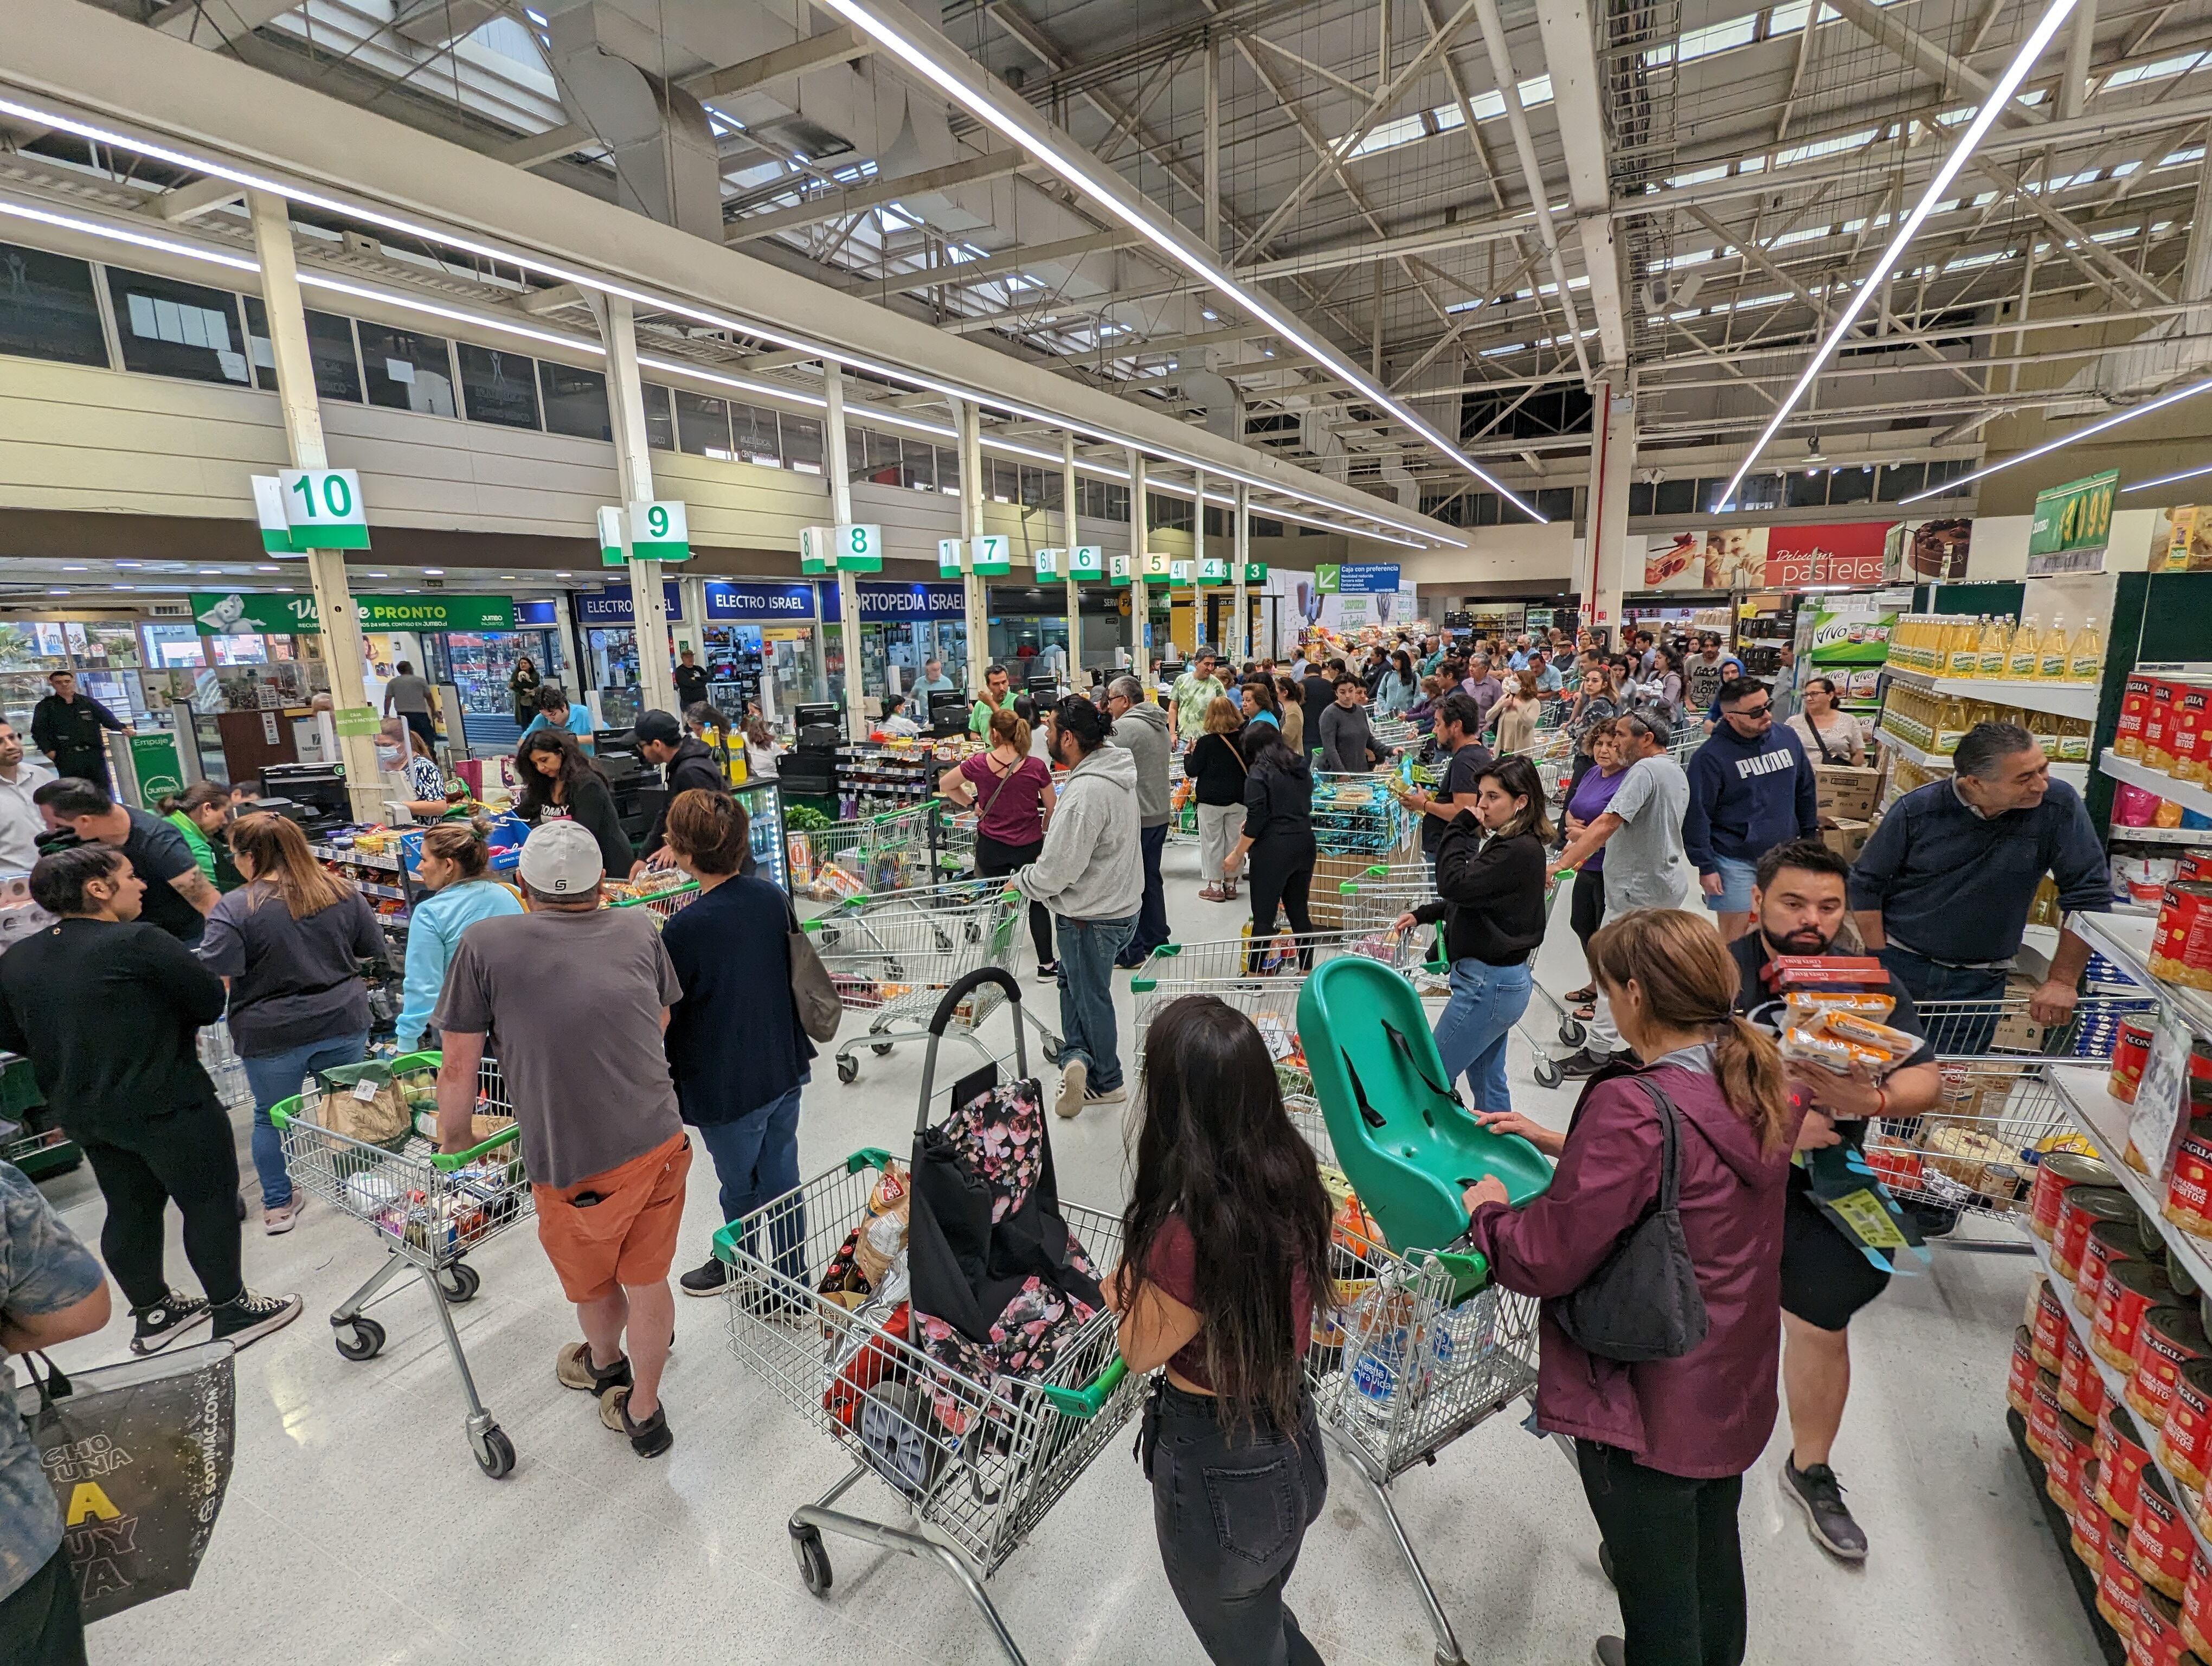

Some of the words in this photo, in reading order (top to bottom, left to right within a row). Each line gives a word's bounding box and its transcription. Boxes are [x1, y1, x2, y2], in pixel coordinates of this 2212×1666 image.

[292, 473, 352, 518] 10
[647, 505, 669, 538] 9
[803, 531, 810, 556] 8
[852, 528, 868, 553] 8
[943, 543, 948, 564] 7
[983, 539, 998, 561] 7
[1079, 548, 1091, 567] 6
[1040, 552, 1047, 570] 6
[1115, 559, 1121, 575] 5
[1151, 555, 1161, 572] 5
[1173, 562, 1179, 576] 4
[1205, 561, 1214, 575] 4
[1251, 564, 1260, 578] 3
[1782, 558, 1883, 586] pasteles
[587, 599, 633, 613] ELECTRO
[716, 594, 766, 609] ELECTRO
[769, 597, 805, 610] ISRAEL
[929, 593, 966, 610] ISRAEL
[374, 606, 447, 619] PRONTO
[1980, 656, 2003, 664] Belmont
[2012, 657, 2036, 665] Belmont
[2043, 658, 2065, 667] Belmont
[2074, 659, 2098, 668] Belmont
[134, 737, 169, 746] Empuje
[1735, 748, 1794, 779] PUMA
[1359, 1358, 1385, 1378] Nestlé
[202, 1386, 219, 1495] SODIMAC.COM
[66, 1481, 121, 1527] A
